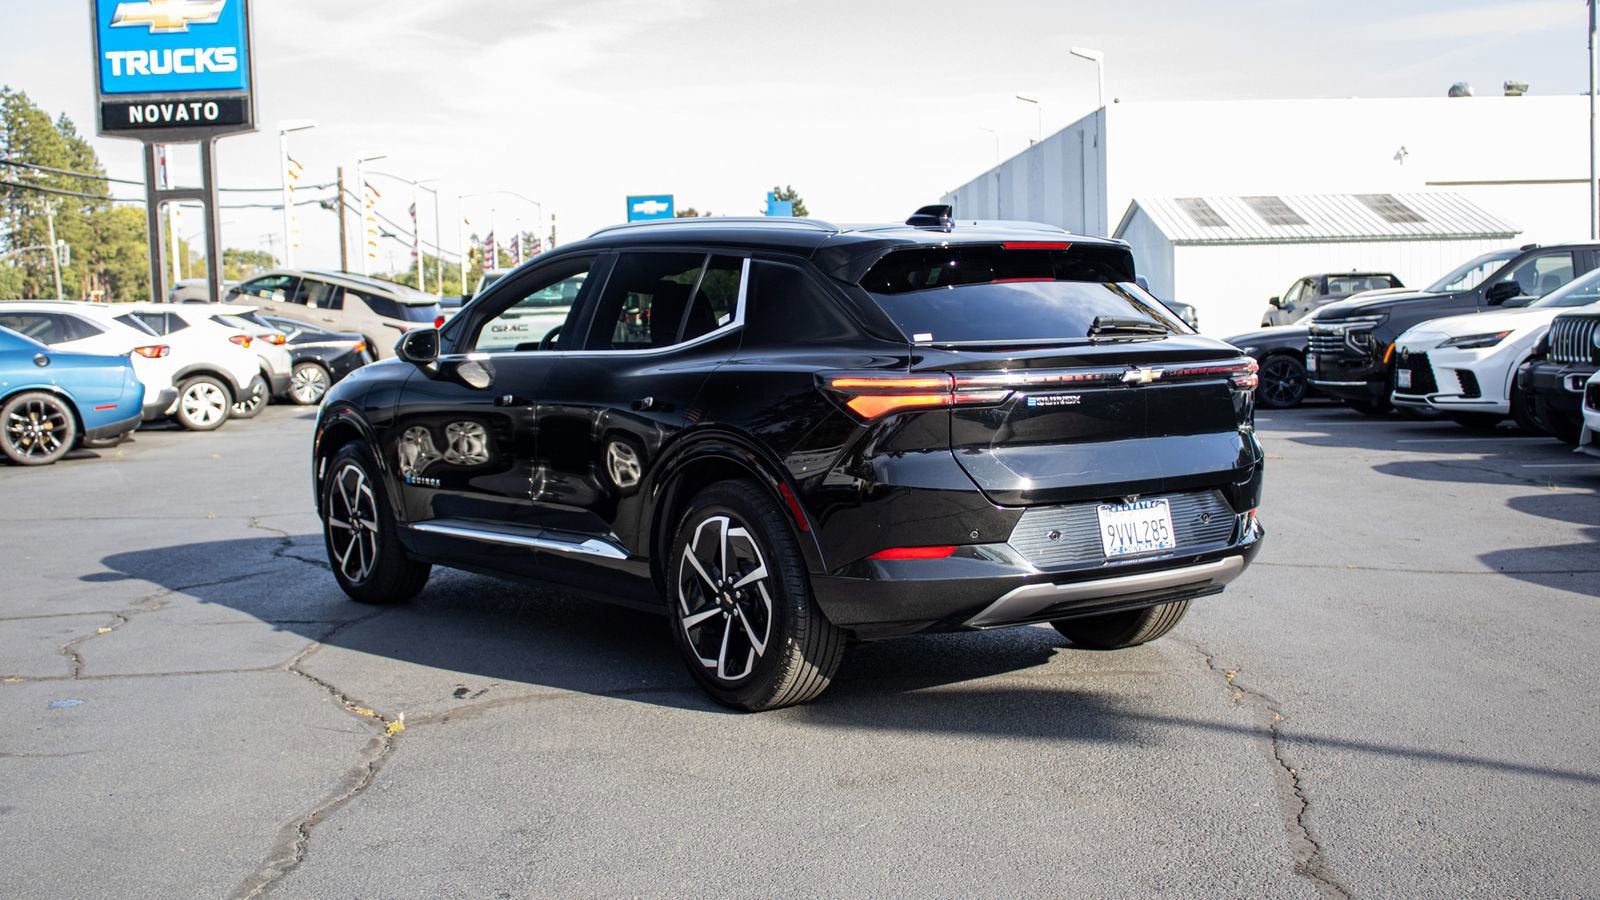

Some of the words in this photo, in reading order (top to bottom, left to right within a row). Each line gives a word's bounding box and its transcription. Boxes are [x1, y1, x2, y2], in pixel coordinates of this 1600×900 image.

[105, 47, 238, 76] TRUCKS
[128, 101, 219, 123] NOVATO
[1107, 518, 1169, 547] 9VVL285
